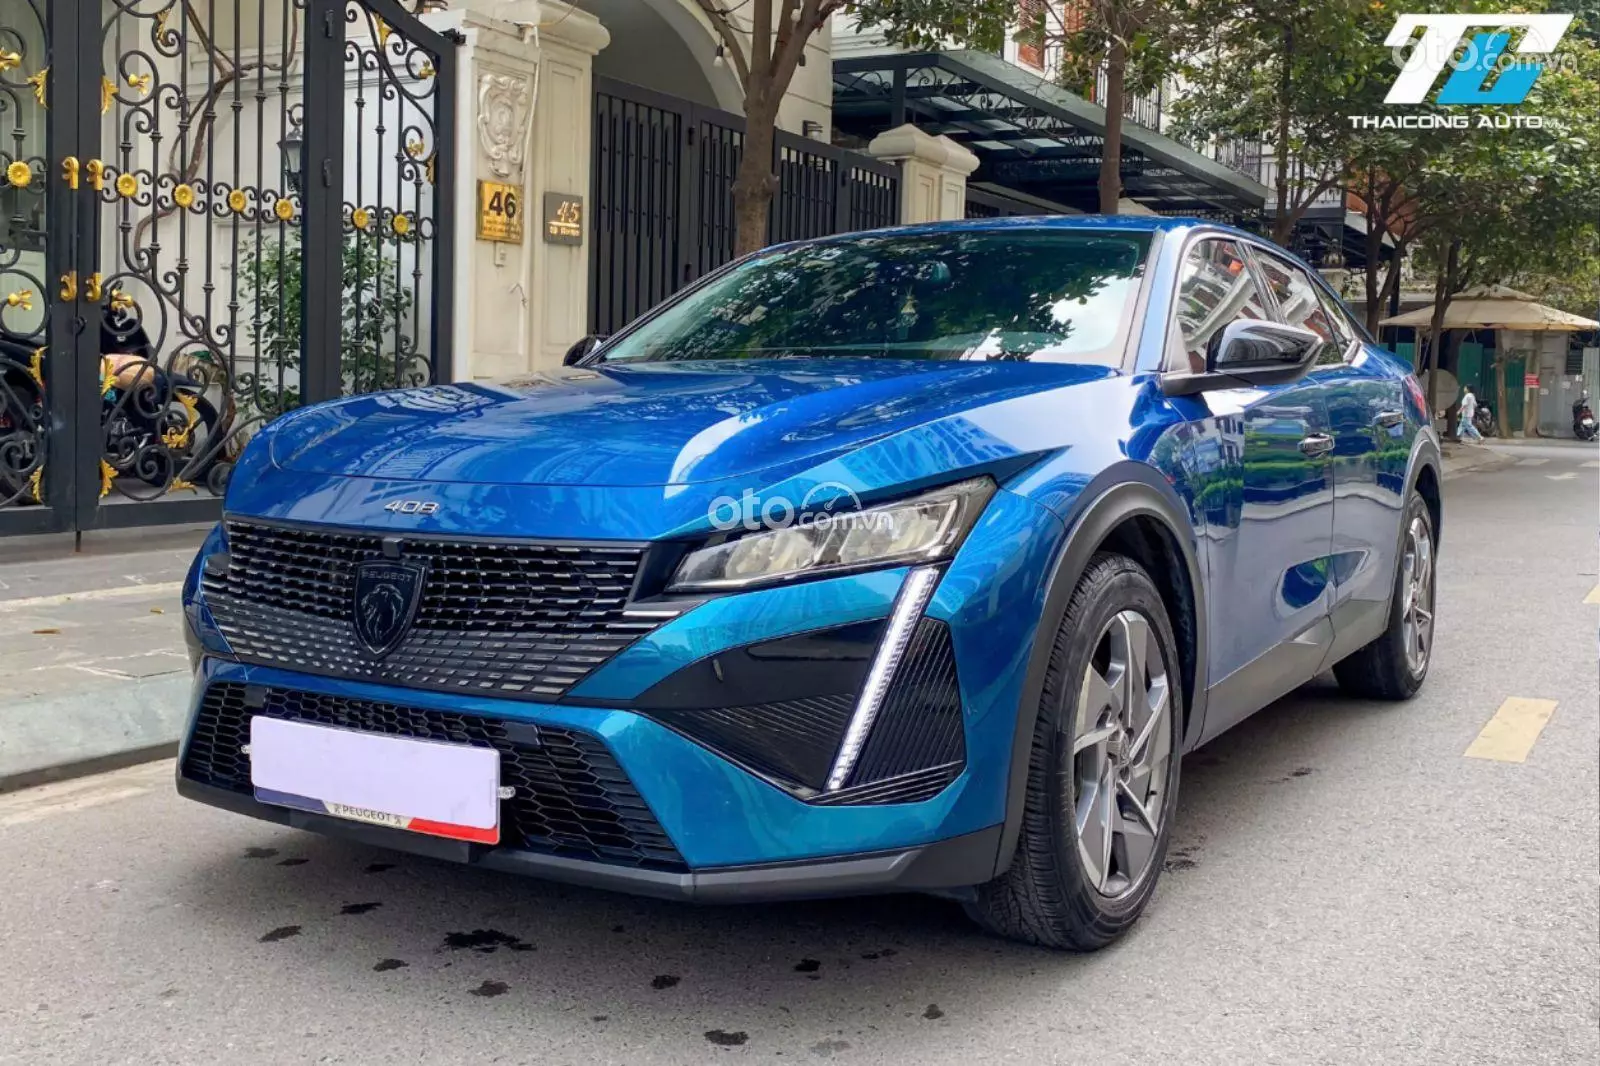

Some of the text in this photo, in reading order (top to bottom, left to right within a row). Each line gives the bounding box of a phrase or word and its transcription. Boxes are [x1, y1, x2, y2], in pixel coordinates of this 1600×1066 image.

[489, 191, 517, 219] 46
[557, 200, 580, 223] 45
[384, 500, 440, 515] 408
[343, 804, 390, 822] PEUGEOT
